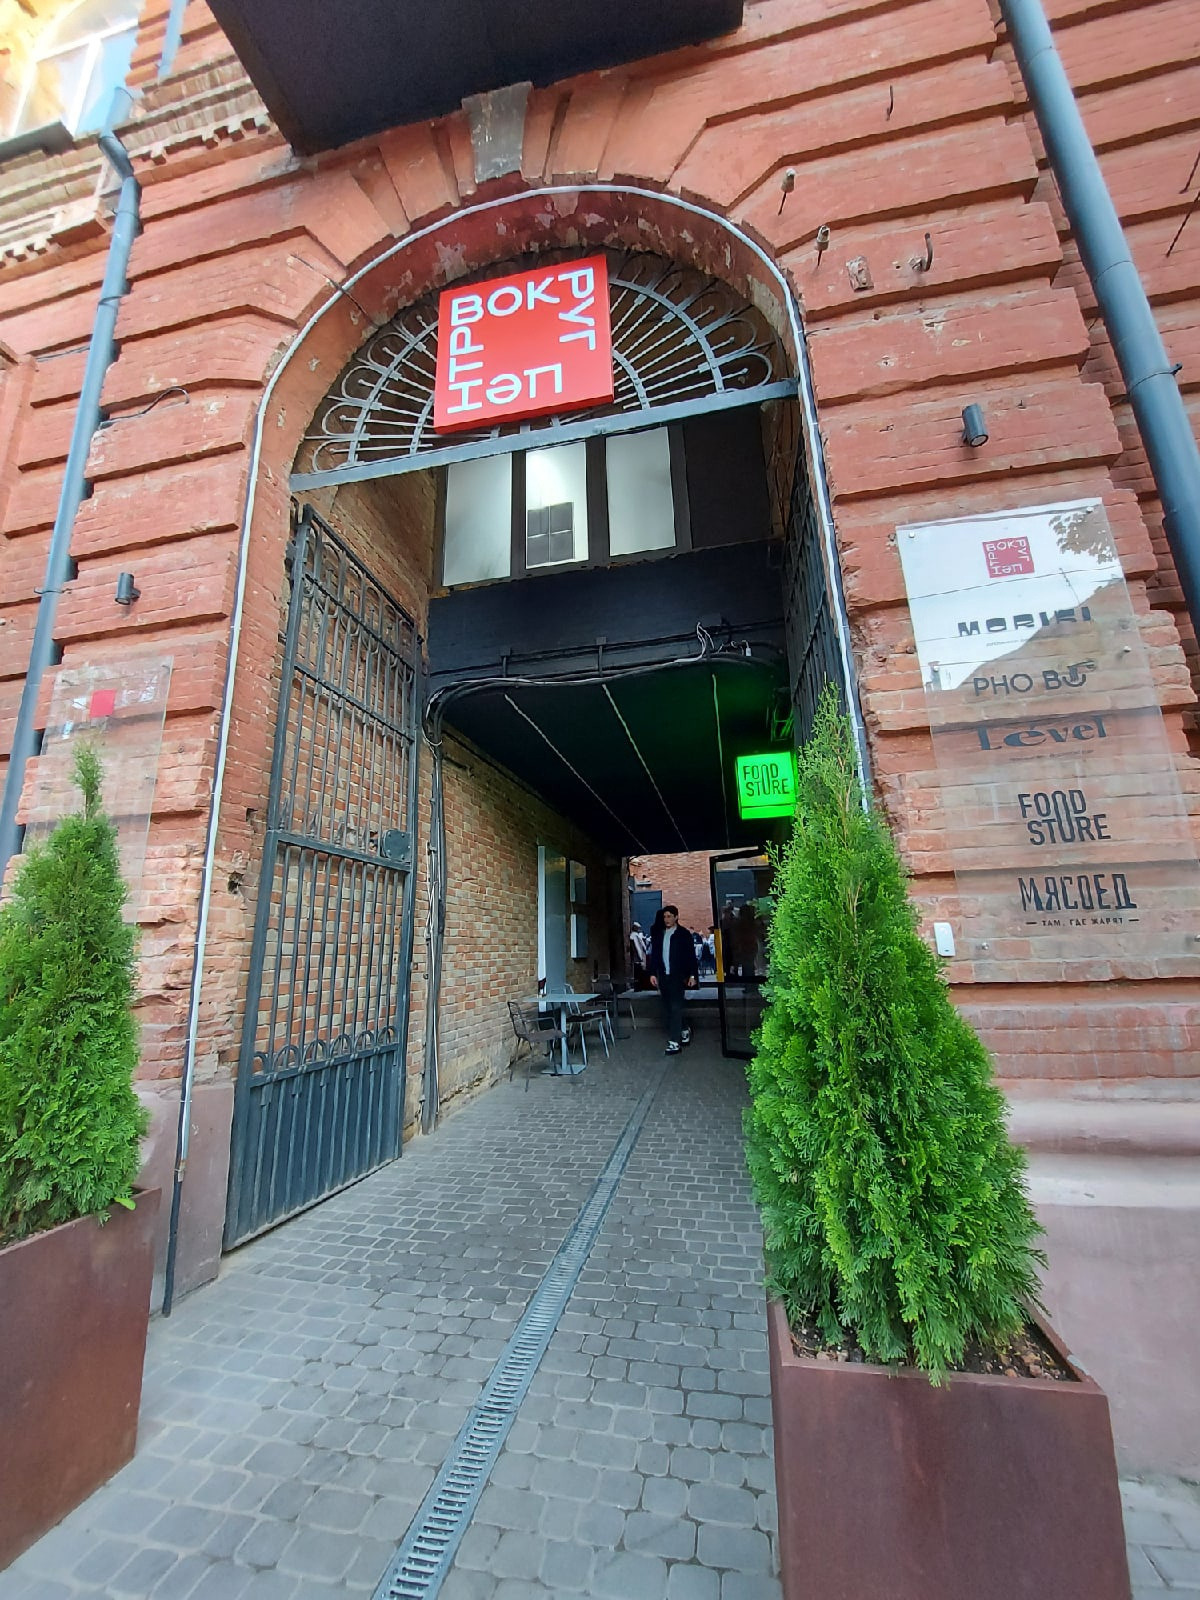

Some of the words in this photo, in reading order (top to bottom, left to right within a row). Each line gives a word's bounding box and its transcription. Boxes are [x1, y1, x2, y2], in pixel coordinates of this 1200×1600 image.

[973, 673, 1034, 697] PHO
[742, 763, 779, 781] FOOD
[1018, 789, 1087, 820] FOOD
[1017, 873, 1138, 912] МЯСОЕД
